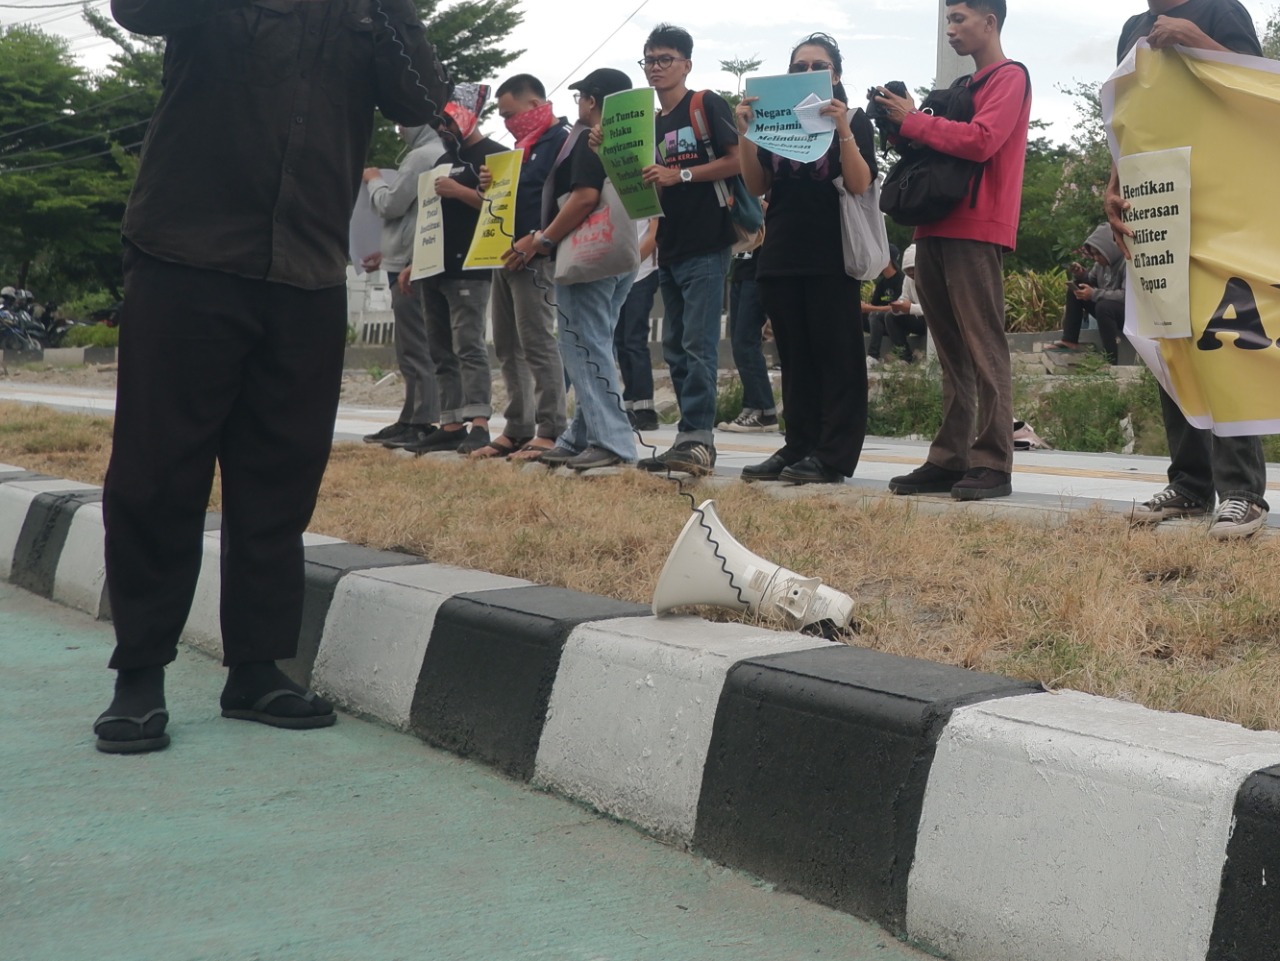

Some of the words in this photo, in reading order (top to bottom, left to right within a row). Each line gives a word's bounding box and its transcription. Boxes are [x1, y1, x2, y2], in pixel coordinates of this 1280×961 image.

[616, 110, 645, 123] Tuntas
[755, 108, 792, 119] Negara
[609, 126, 632, 139] Pelaku
[603, 139, 644, 156] Penyiraman
[1122, 180, 1174, 200] Hentikan
[1122, 203, 1179, 224] Kekerasan
[1132, 228, 1168, 246] Militer
[1134, 254, 1141, 269] di
[1140, 250, 1174, 268] Tanah
[1139, 276, 1167, 293] Papua
